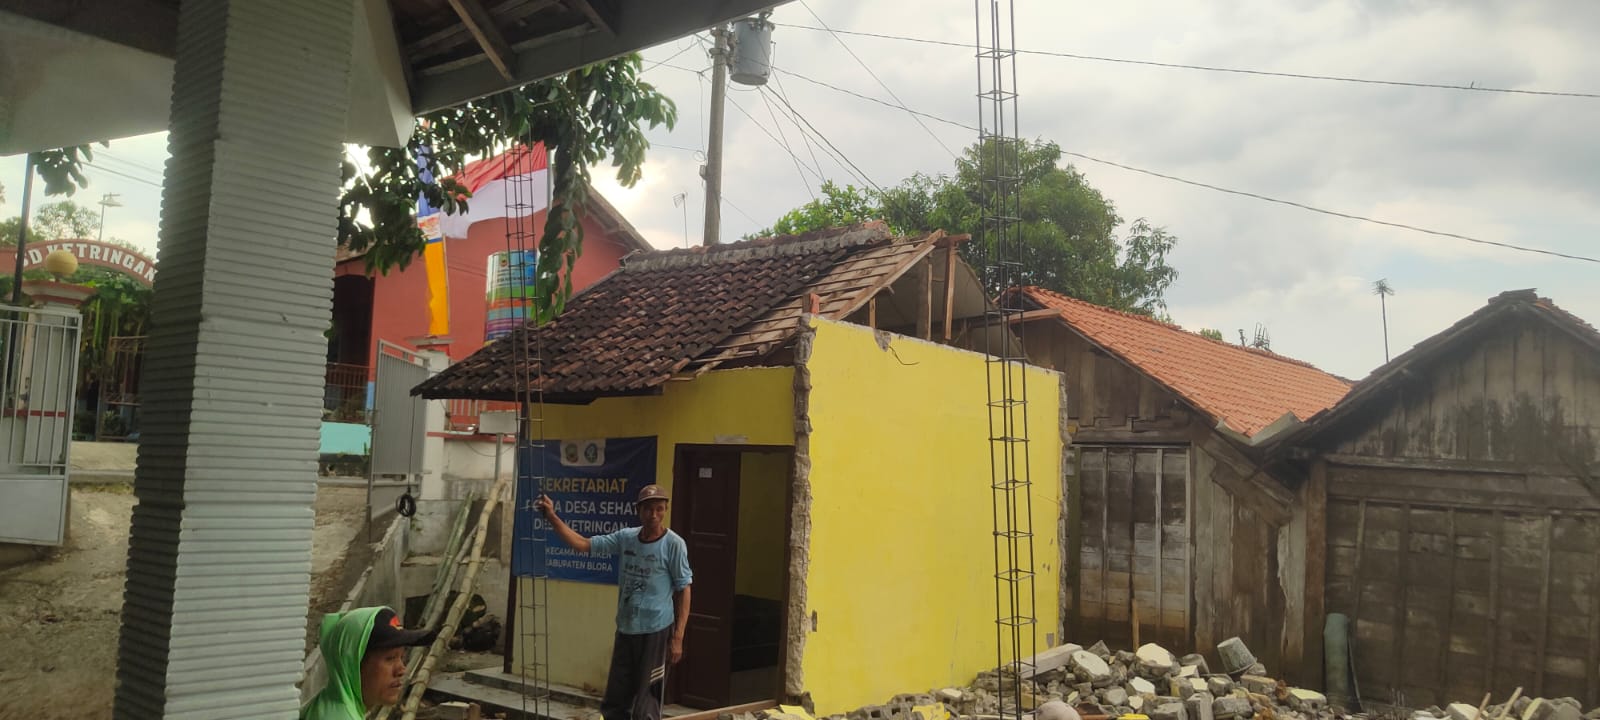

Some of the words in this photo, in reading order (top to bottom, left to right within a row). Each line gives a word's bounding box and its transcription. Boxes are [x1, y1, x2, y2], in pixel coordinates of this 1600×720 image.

[538, 477, 628, 494] SEKRETARIAT
[565, 500, 596, 514] DESA
[599, 501, 638, 516] SEHAT
[587, 561, 613, 572] BLORA
